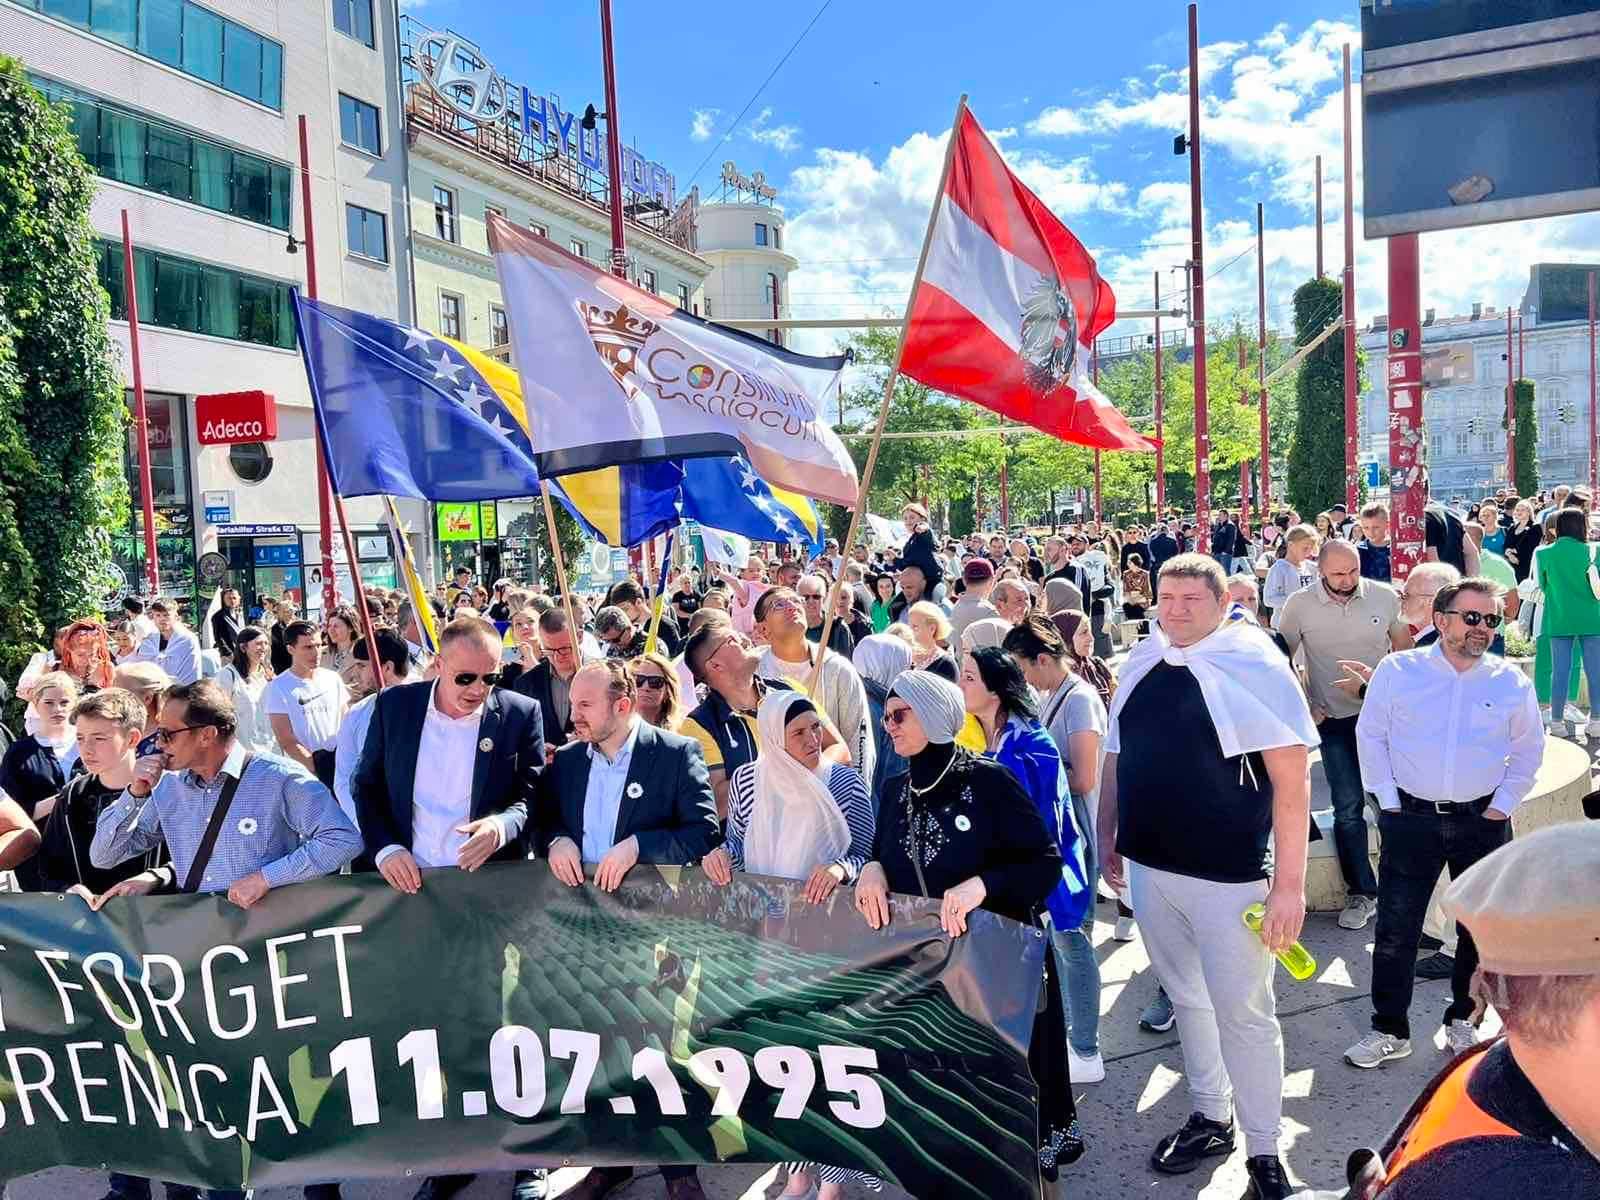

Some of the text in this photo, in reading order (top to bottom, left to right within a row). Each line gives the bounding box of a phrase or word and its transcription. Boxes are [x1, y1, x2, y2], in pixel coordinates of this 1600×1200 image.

[202, 419, 262, 440] Adecco
[34, 925, 363, 1045] FORGET
[0, 1028, 887, 1142] RENICA 11.07.1995
